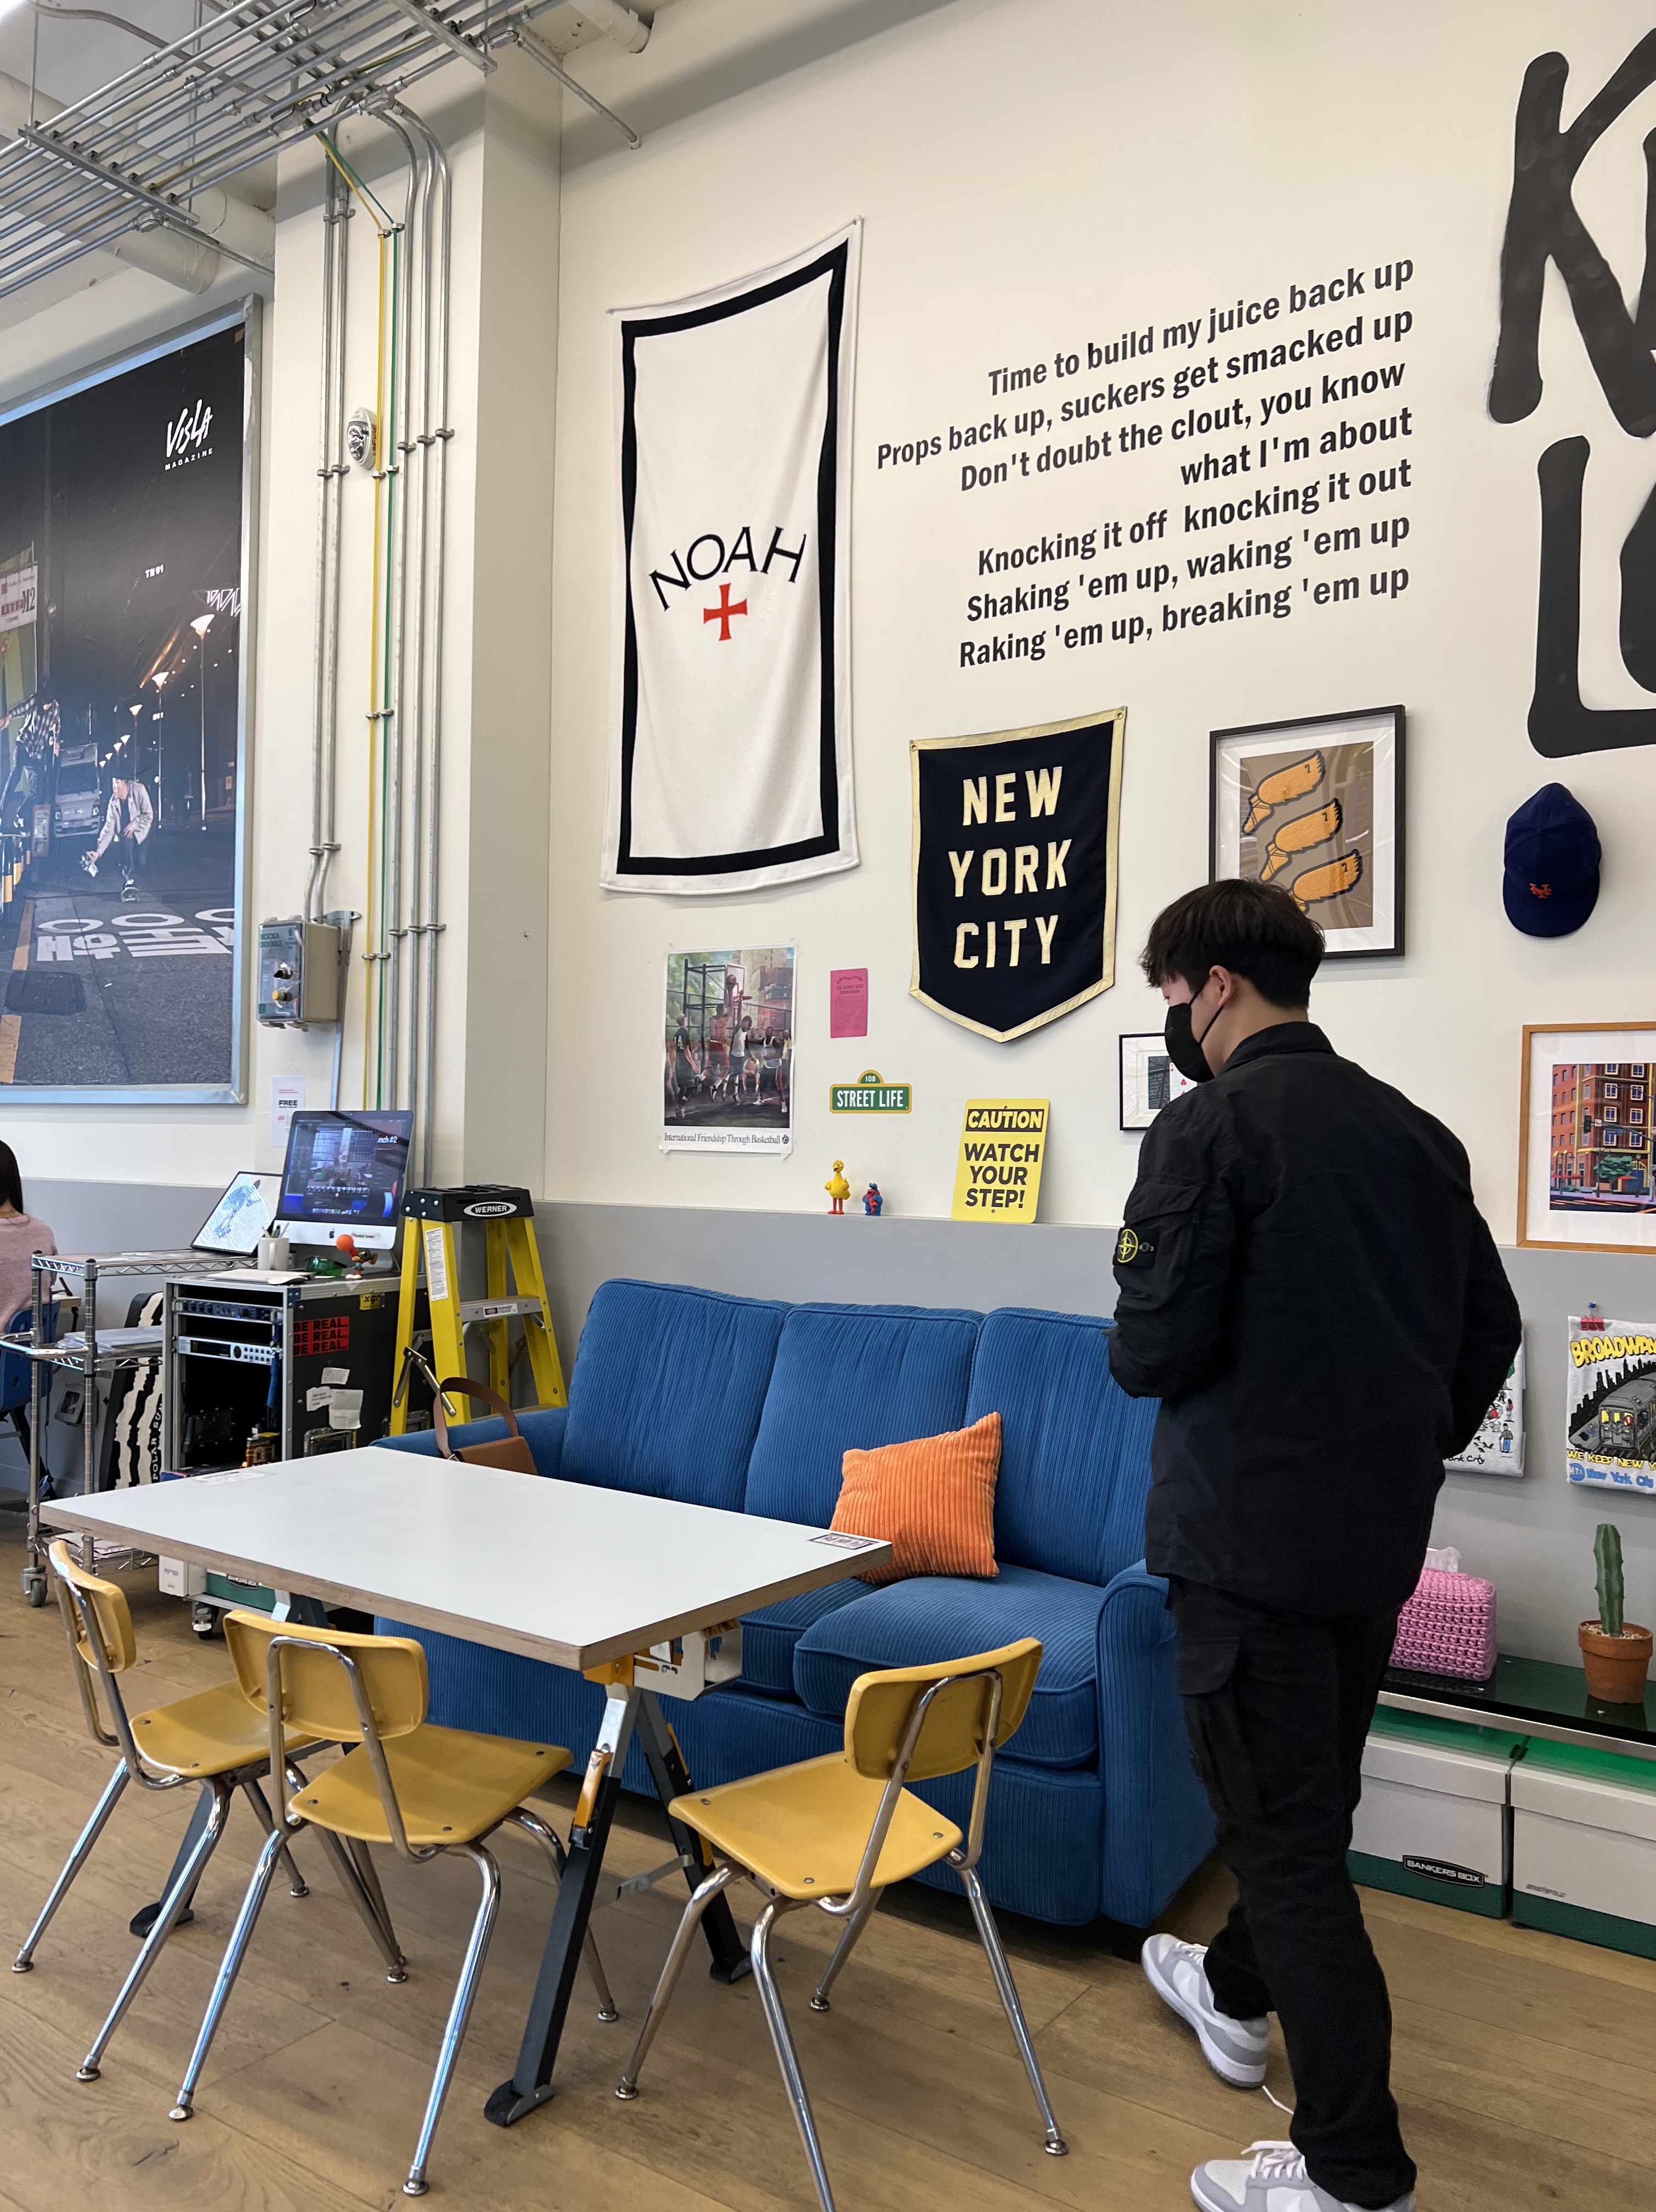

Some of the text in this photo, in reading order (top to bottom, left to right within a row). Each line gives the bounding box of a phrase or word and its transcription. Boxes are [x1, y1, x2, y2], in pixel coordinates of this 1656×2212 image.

[988, 260, 1413, 396] Time to build my juice back up
[878, 311, 1412, 469] Props back up, suckers get smacked up
[166, 399, 213, 458] VISLA
[962, 363, 1405, 491] Don't doubt the clout, you know
[1180, 407, 1412, 485] what I'm about
[165, 448, 213, 471] MAGAZINE
[979, 459, 1411, 575] Knocking it off knocking it out
[649, 527, 806, 612] NOAH
[967, 517, 1409, 621] Shaking 'em up, waking 'em up
[960, 569, 1408, 667] Raking 'em up, breaking 'em up
[963, 766, 1062, 826] NEW
[948, 839, 1072, 898] YORK
[954, 915, 1059, 969] CITY
[837, 1090, 904, 1107] STREET LIFE
[968, 1111, 1043, 1128] CAUTION
[665, 1132, 781, 1145] International Friendship Through Basketball
[964, 1143, 1040, 1162] WATCH
[970, 1166, 1027, 1185] YOUR
[474, 1205, 507, 1214] WERNER
[965, 1188, 1025, 1209] STEP!
[293, 1318, 348, 1333] BE REAL.
[293, 1329, 348, 1344] BE REAL.
[293, 1340, 348, 1355] BE REAL.
[1467, 1454, 1485, 1465] City
[1567, 1449, 1585, 1460] WE
[1587, 1454, 1614, 1465] KEEP
[1618, 1458, 1644, 1469] NEW
[1586, 1469, 1607, 1480] New
[1610, 1471, 1632, 1484] York
[1636, 1475, 1653, 1488] City
[1407, 1860, 1480, 1883] BANKERS BOX
